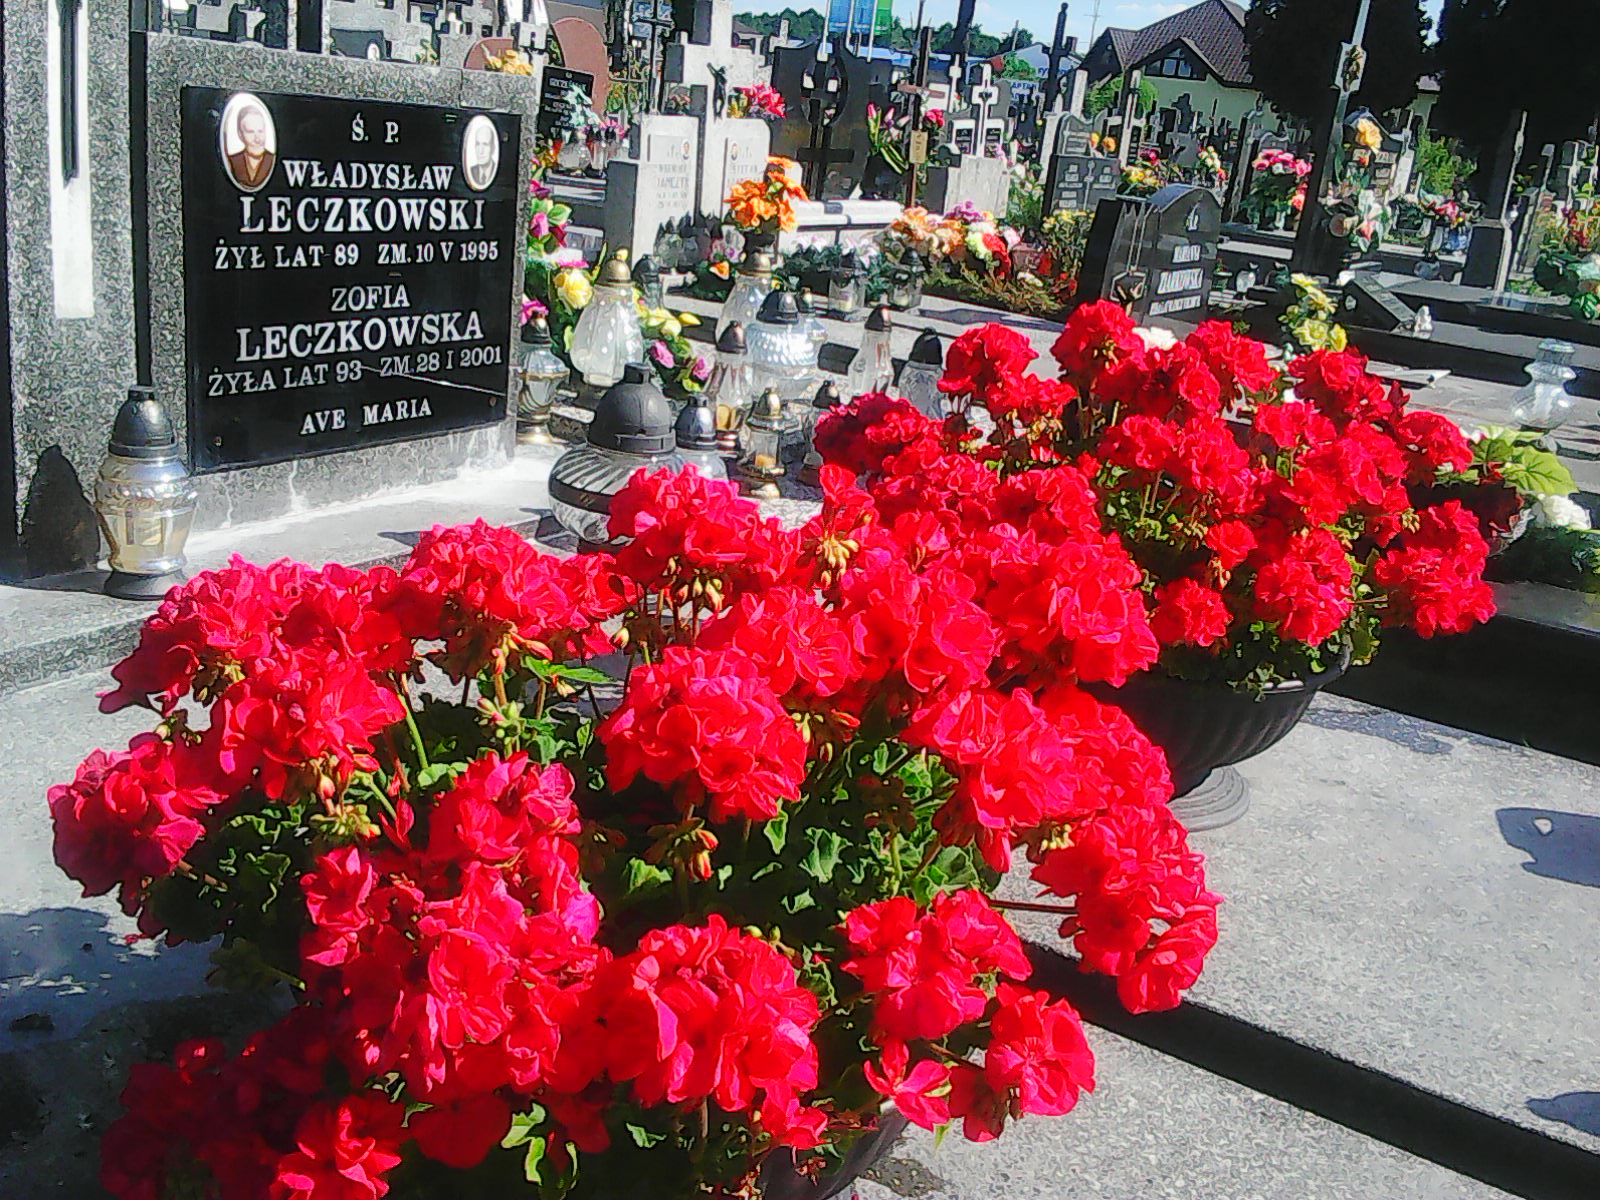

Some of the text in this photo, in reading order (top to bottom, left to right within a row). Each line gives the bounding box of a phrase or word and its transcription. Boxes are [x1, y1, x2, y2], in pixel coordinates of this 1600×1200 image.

[283, 160, 453, 190] WŁADYSŁAW
[240, 197, 484, 232] LECZKOWSKI
[216, 239, 264, 269] ŻYŁ
[275, 246, 324, 267] LAT
[335, 244, 358, 265] 89
[415, 243, 434, 263] 10
[440, 242, 454, 262] V
[461, 241, 497, 260] 1995
[332, 285, 410, 311] ZOFIA
[237, 311, 484, 362] LECZKOWSKA
[209, 368, 276, 396] ŻYŁA
[284, 364, 328, 388] LAT
[337, 360, 362, 382] 93
[417, 353, 439, 372] 28
[447, 351, 453, 369] I
[461, 346, 501, 366] 2001
[301, 399, 431, 434] AVE MARIA
